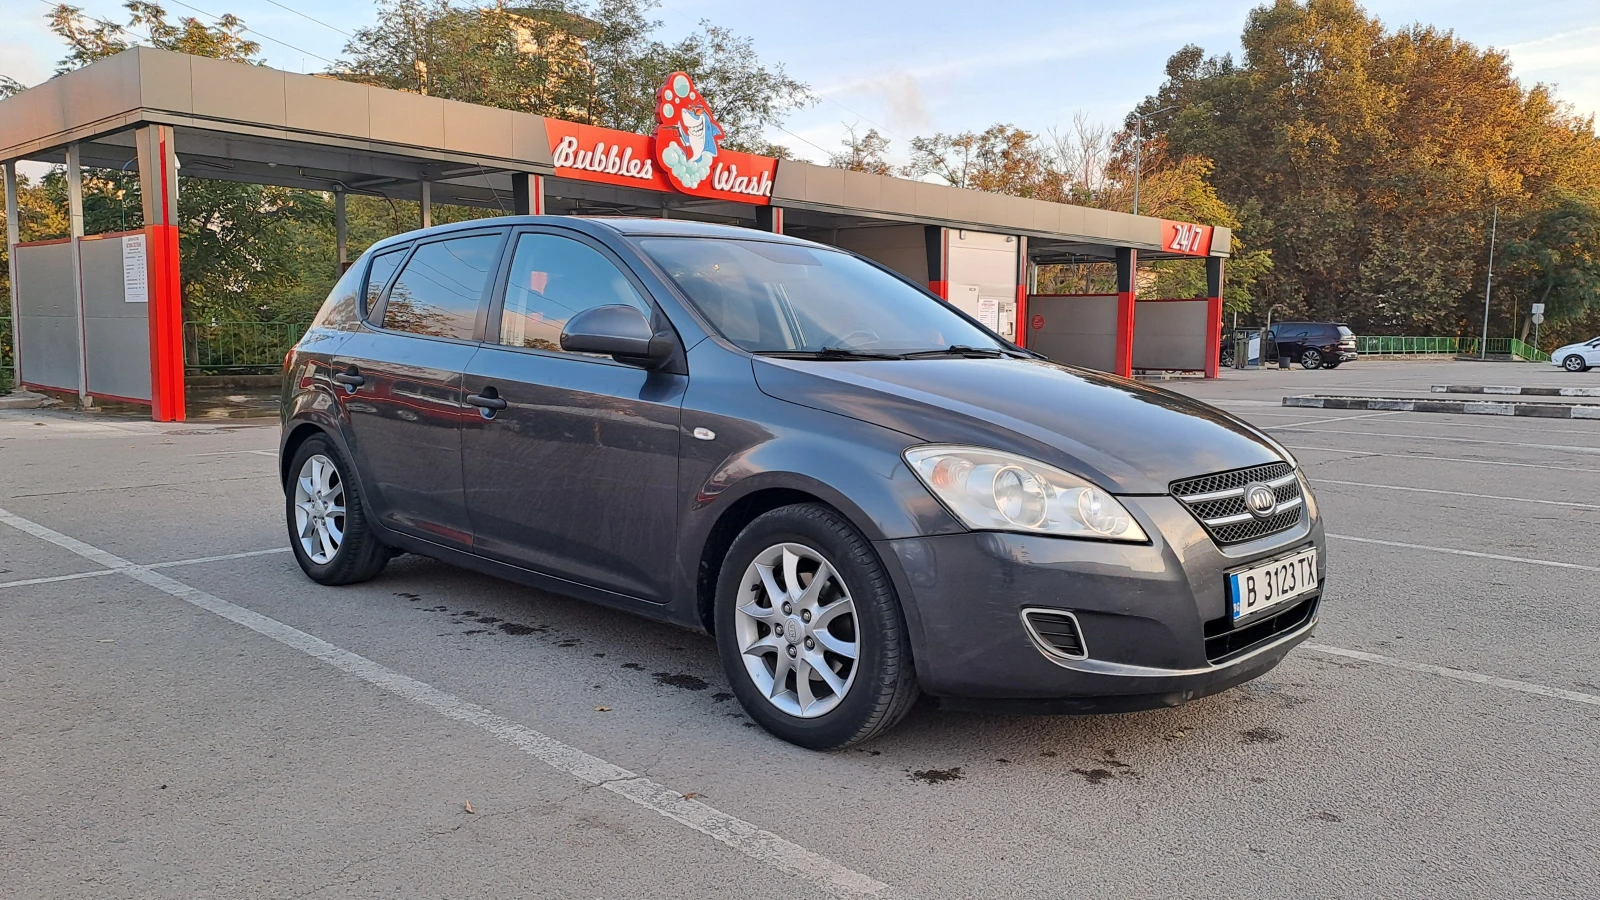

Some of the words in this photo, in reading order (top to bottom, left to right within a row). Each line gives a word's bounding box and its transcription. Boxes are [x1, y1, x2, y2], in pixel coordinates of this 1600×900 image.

[552, 136, 653, 180] Bubbles
[712, 162, 772, 197] Wash
[1169, 224, 1202, 252] 24/7
[1252, 492, 1273, 509] KIA
[1246, 576, 1257, 608] B
[1264, 562, 1297, 601] 3123
[1298, 554, 1315, 588] TX
